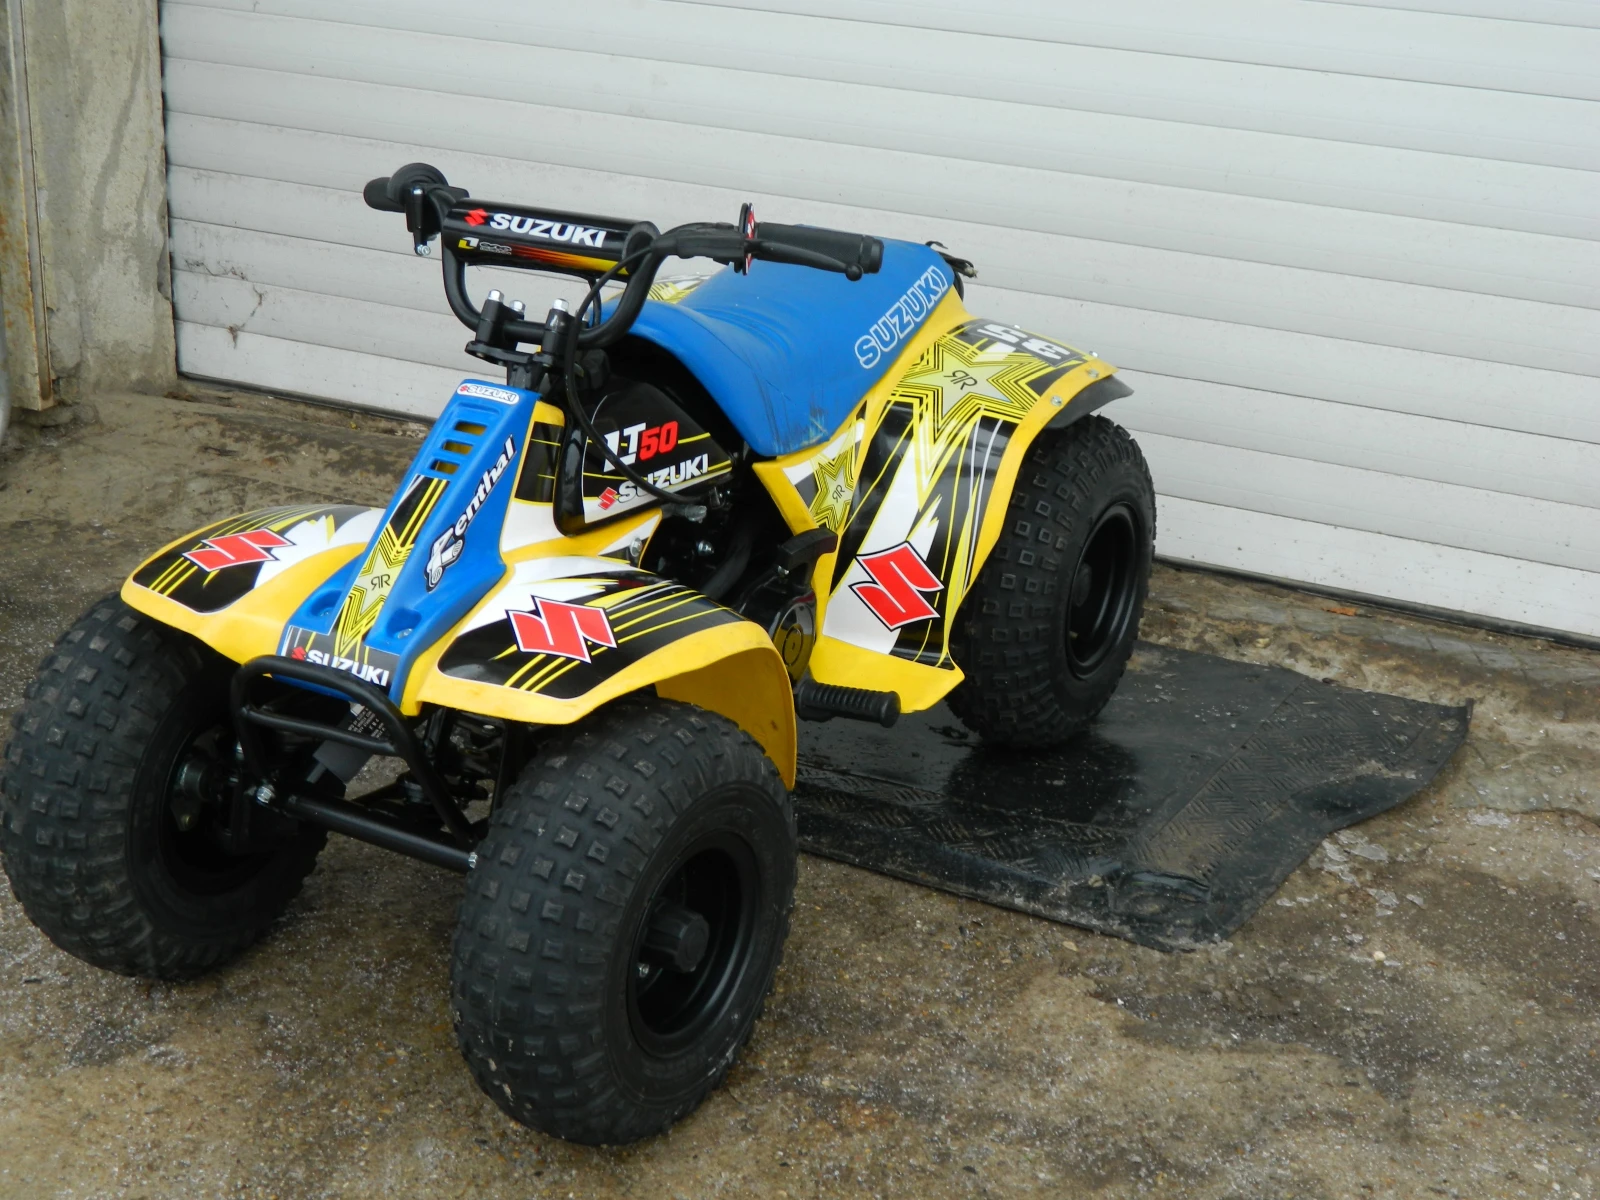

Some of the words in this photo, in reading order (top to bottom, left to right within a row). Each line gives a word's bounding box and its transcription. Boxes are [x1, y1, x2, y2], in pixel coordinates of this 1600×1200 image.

[490, 213, 607, 248] SUZUKI
[855, 265, 948, 369] SUZUKI
[467, 385, 517, 402] SUZUKI
[306, 649, 390, 687] SUZUKI
